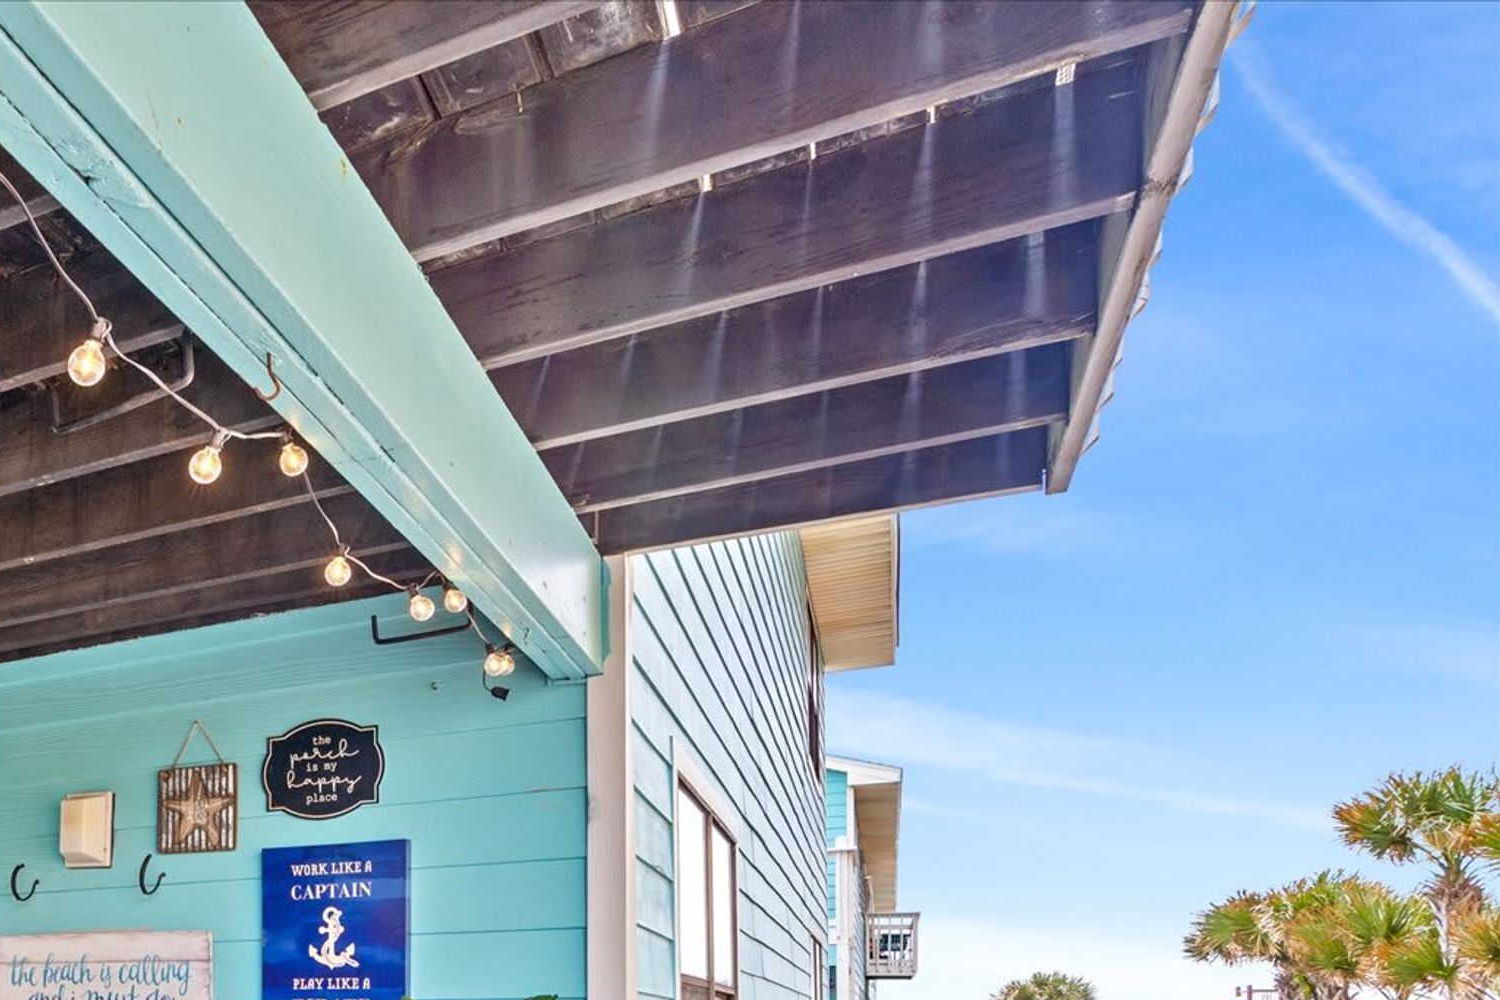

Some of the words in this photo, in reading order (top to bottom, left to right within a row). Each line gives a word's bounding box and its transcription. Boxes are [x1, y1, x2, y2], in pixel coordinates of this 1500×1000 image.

[311, 735, 332, 746] the
[289, 738, 360, 770] porch
[306, 762, 319, 773] is
[323, 761, 338, 773] my
[286, 769, 362, 794] happy
[306, 792, 339, 806] place
[290, 863, 329, 877] WORK
[331, 860, 362, 875] LIKE
[364, 860, 373, 873] A
[290, 880, 373, 901] CAPTAIN
[11, 954, 38, 988] the
[43, 952, 94, 988] beach
[99, 960, 112, 990] is
[118, 954, 192, 997] calling
[292, 977, 325, 990] PLAY
[327, 976, 360, 990] LIKE
[362, 976, 371, 989] A
